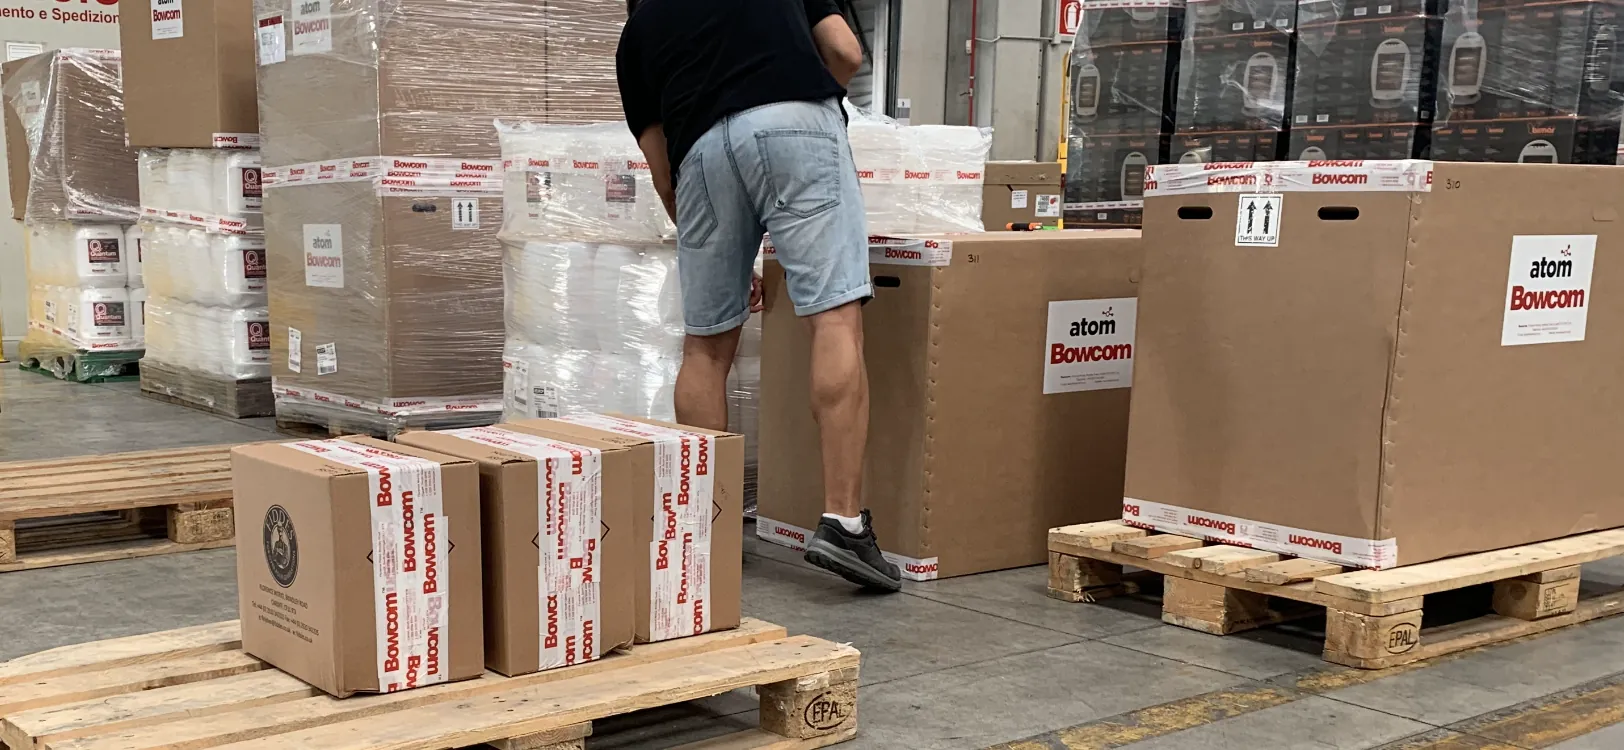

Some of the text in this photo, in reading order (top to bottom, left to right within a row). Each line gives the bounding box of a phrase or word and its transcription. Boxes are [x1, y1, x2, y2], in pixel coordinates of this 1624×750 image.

[39, 10, 47, 20] e
[152, 9, 181, 22] Bowcom
[300, 0, 320, 15] atom
[294, 18, 329, 35] Bowcom
[394, 160, 428, 169] Bowcom
[461, 162, 493, 171] Bowcom
[573, 160, 599, 170] Bowcom
[904, 170, 930, 179] Bowcom
[956, 171, 981, 180] Bowcom
[1208, 174, 1256, 186] Bowcom
[1312, 173, 1368, 184] Bowcom
[1446, 178, 1461, 190] 310
[312, 236, 332, 249] atom
[306, 252, 341, 268] Bowcom
[884, 247, 921, 260] Bowcom
[968, 254, 980, 263] 311
[1530, 257, 1572, 279] atom
[1510, 285, 1585, 311] Bowcom
[1070, 318, 1116, 336] atom
[1050, 343, 1132, 365] Bowcom
[401, 491, 416, 572] Bowcom
[774, 526, 805, 544] Bowcom
[1187, 514, 1235, 535] Bowcom
[1288, 533, 1342, 554] Bowcom
[423, 513, 438, 594] Bowcom
[384, 592, 399, 673] Bowcom
[1388, 629, 1414, 649] EPAL
[812, 700, 847, 723] EPAL
